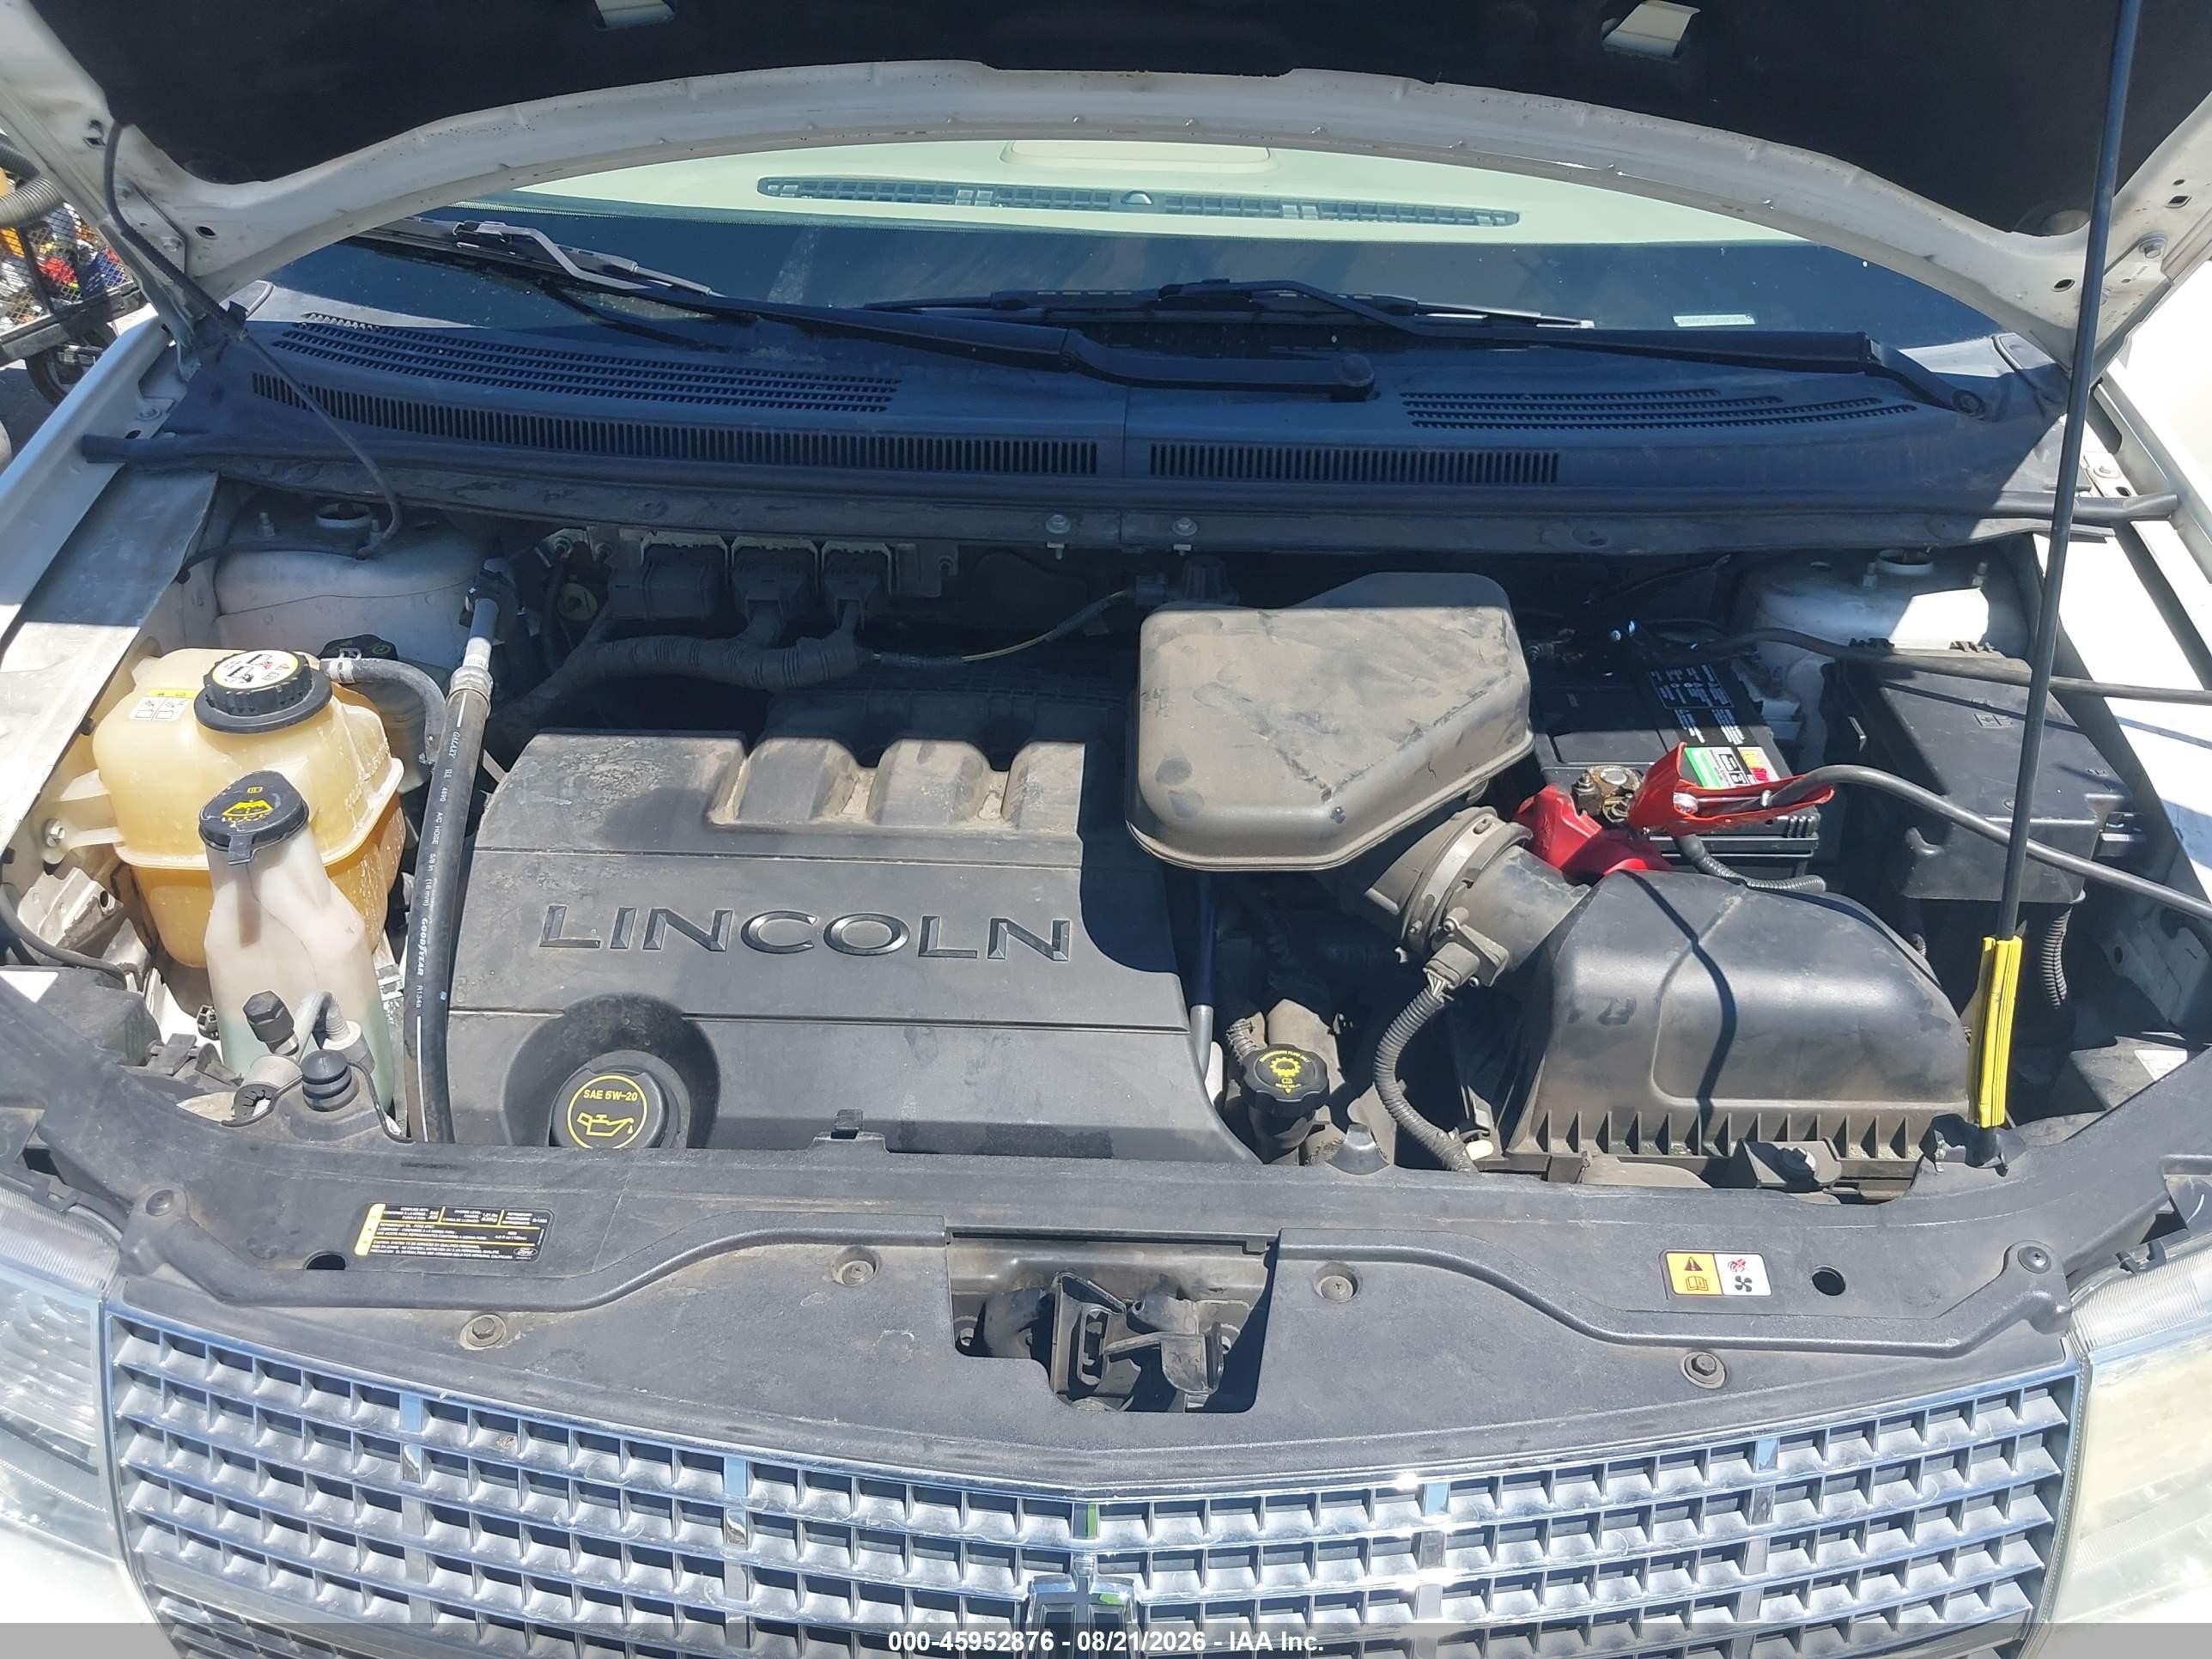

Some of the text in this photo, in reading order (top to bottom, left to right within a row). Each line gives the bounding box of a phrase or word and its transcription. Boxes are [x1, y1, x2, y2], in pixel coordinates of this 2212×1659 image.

[449, 732, 461, 758] GALAXY
[435, 811, 444, 823] A/C
[432, 825, 443, 845] HOSE
[538, 904, 1070, 962] LINCOLN
[416, 917, 428, 976] GOODYEAR
[584, 1089, 638, 1102] SAE 5W-20
